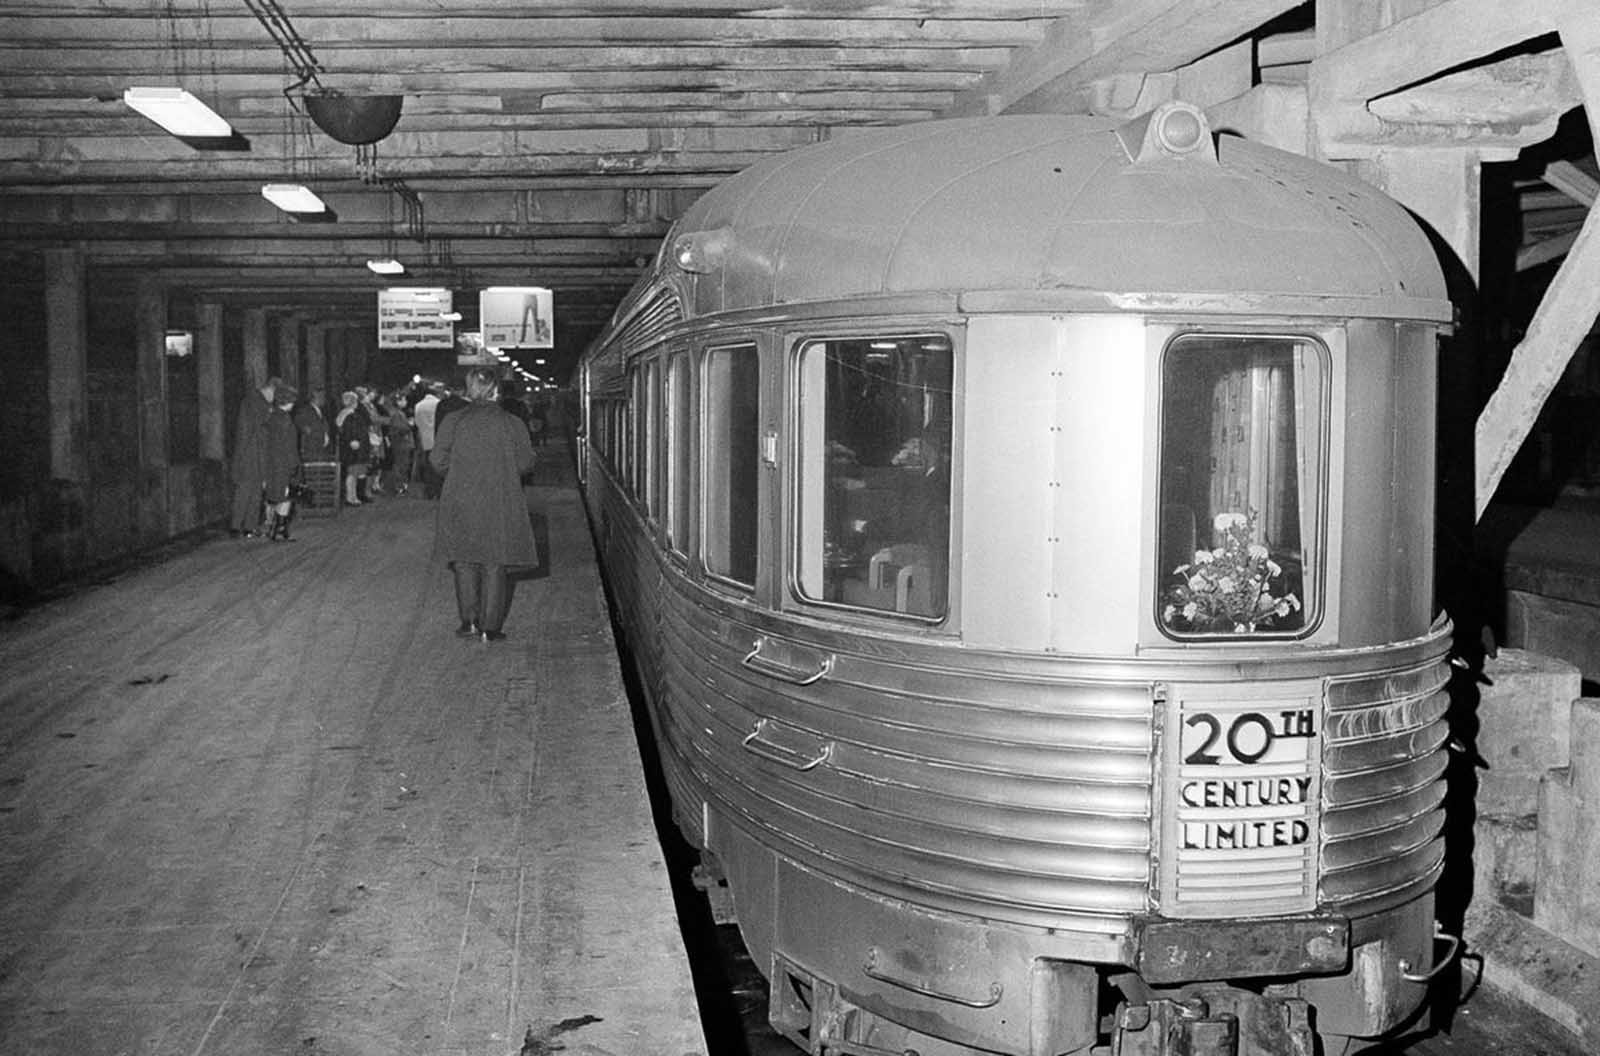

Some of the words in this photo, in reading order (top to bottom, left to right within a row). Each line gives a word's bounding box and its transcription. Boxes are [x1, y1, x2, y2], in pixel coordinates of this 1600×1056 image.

[1184, 710, 1316, 765] 20TH
[1182, 777, 1312, 807] CENTURY
[1183, 820, 1310, 849] LIMITED
